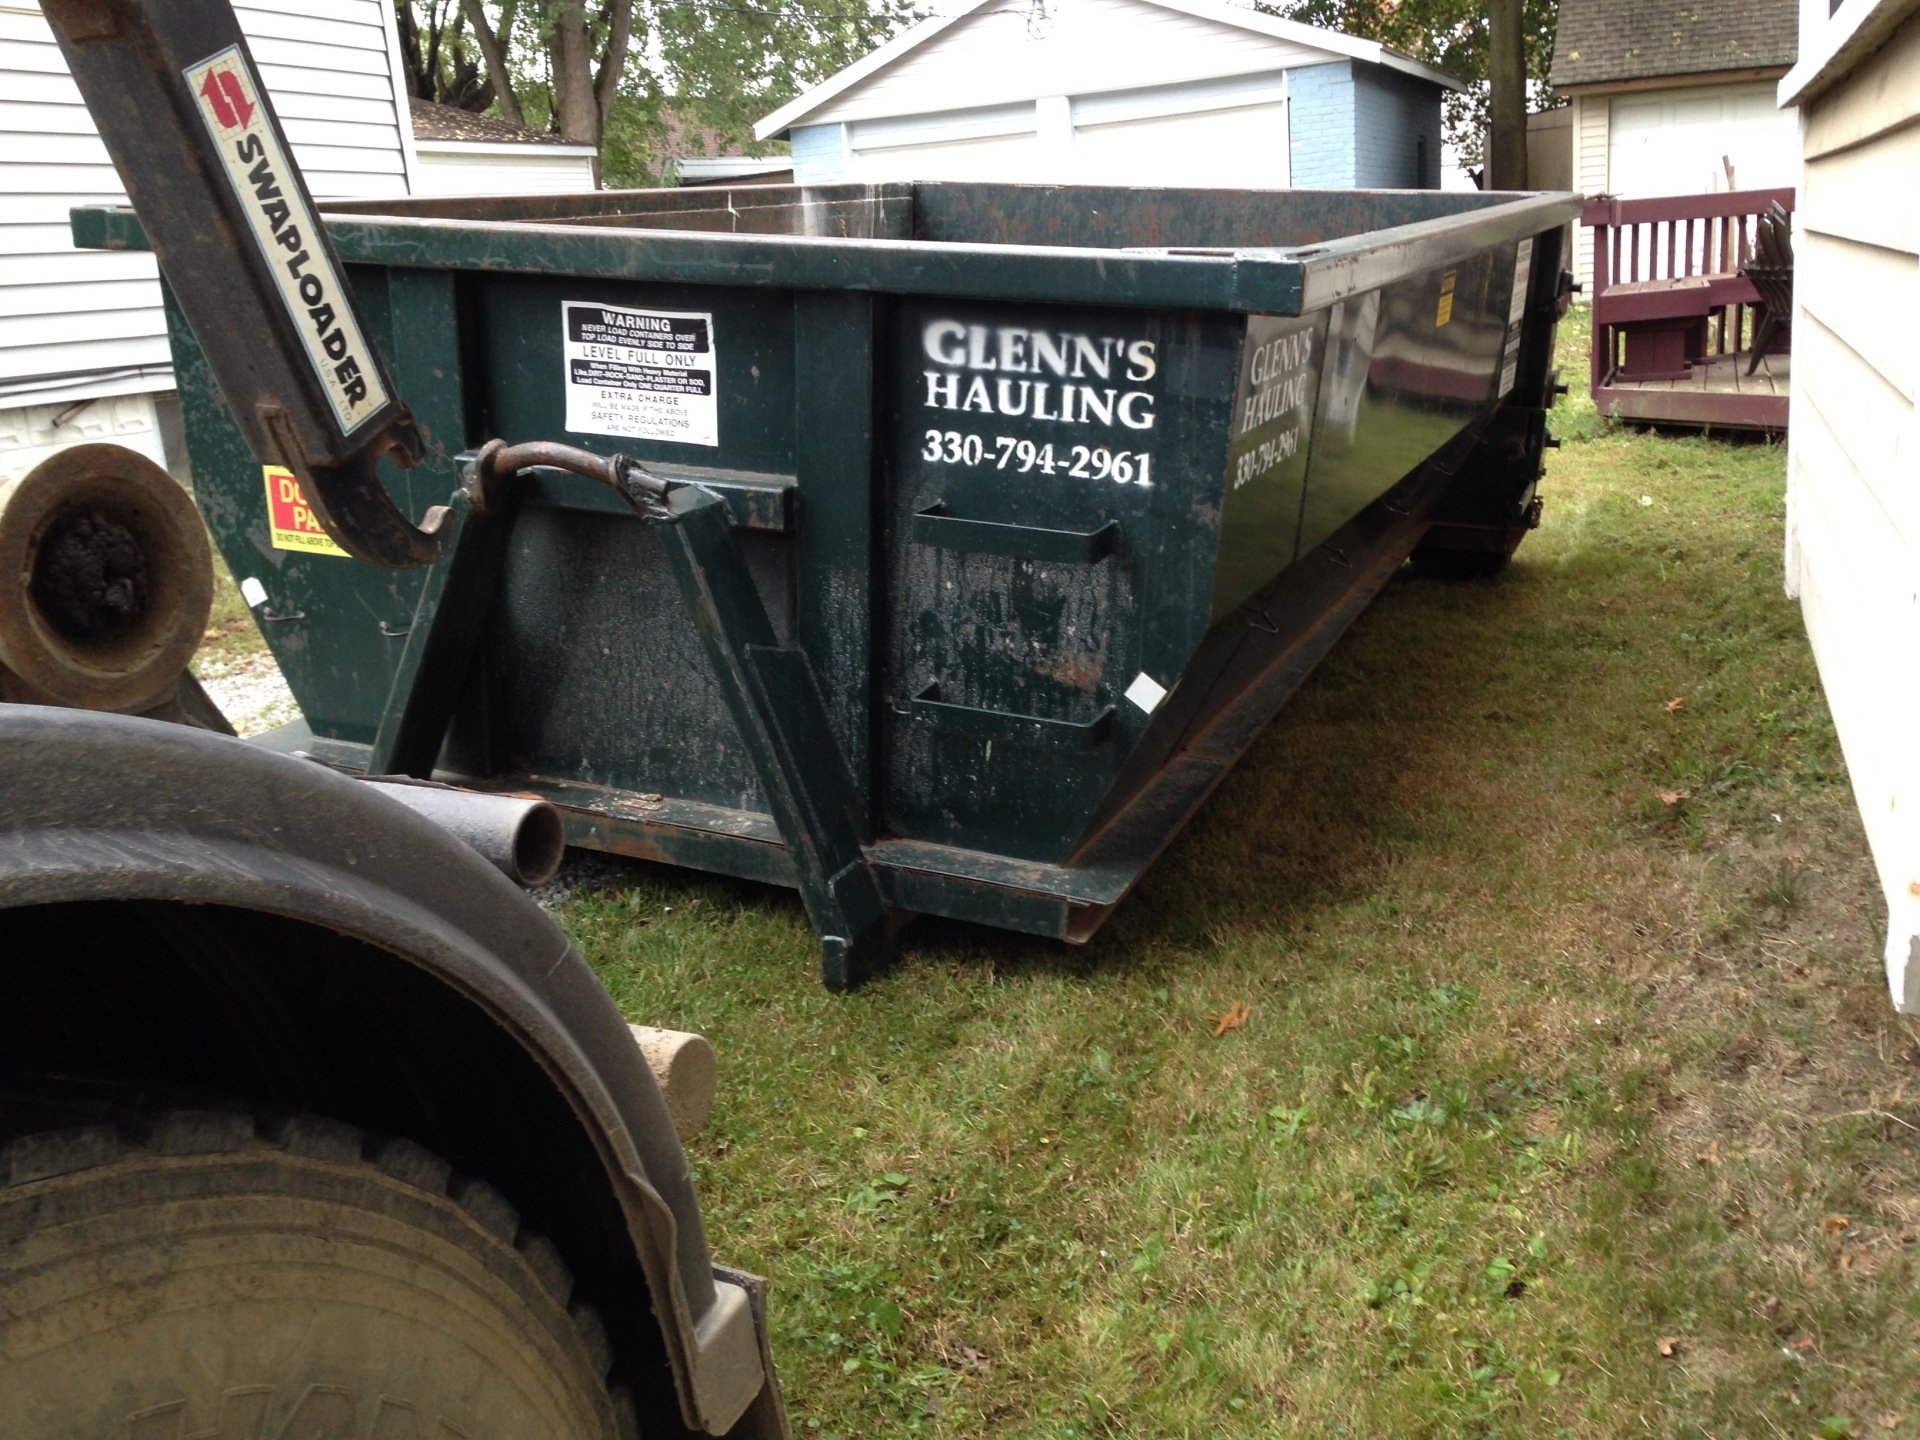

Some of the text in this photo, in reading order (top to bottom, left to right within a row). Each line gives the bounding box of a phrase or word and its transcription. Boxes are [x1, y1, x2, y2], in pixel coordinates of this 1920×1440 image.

[236, 133, 368, 410] SWAPLOADER
[581, 323, 696, 342] NEVER LOAD CONTAINERS OVER
[581, 332, 695, 351] TOP LOAD EVENLY SIDE TO SIDE
[601, 310, 671, 332] WARNING
[922, 318, 1157, 382] GLENN'S
[582, 345, 696, 367] LEVEL FULL ONLY
[1250, 327, 1314, 386] GLENN'S
[591, 411, 690, 429] SAFETY REGULATIONS
[601, 390, 679, 406] EXTRA CHARGE
[922, 371, 1156, 430] HAULING
[1240, 373, 1307, 434] HAULING
[921, 429, 1155, 487] 330-794-2961
[1233, 427, 1300, 491] 330-794-2961
